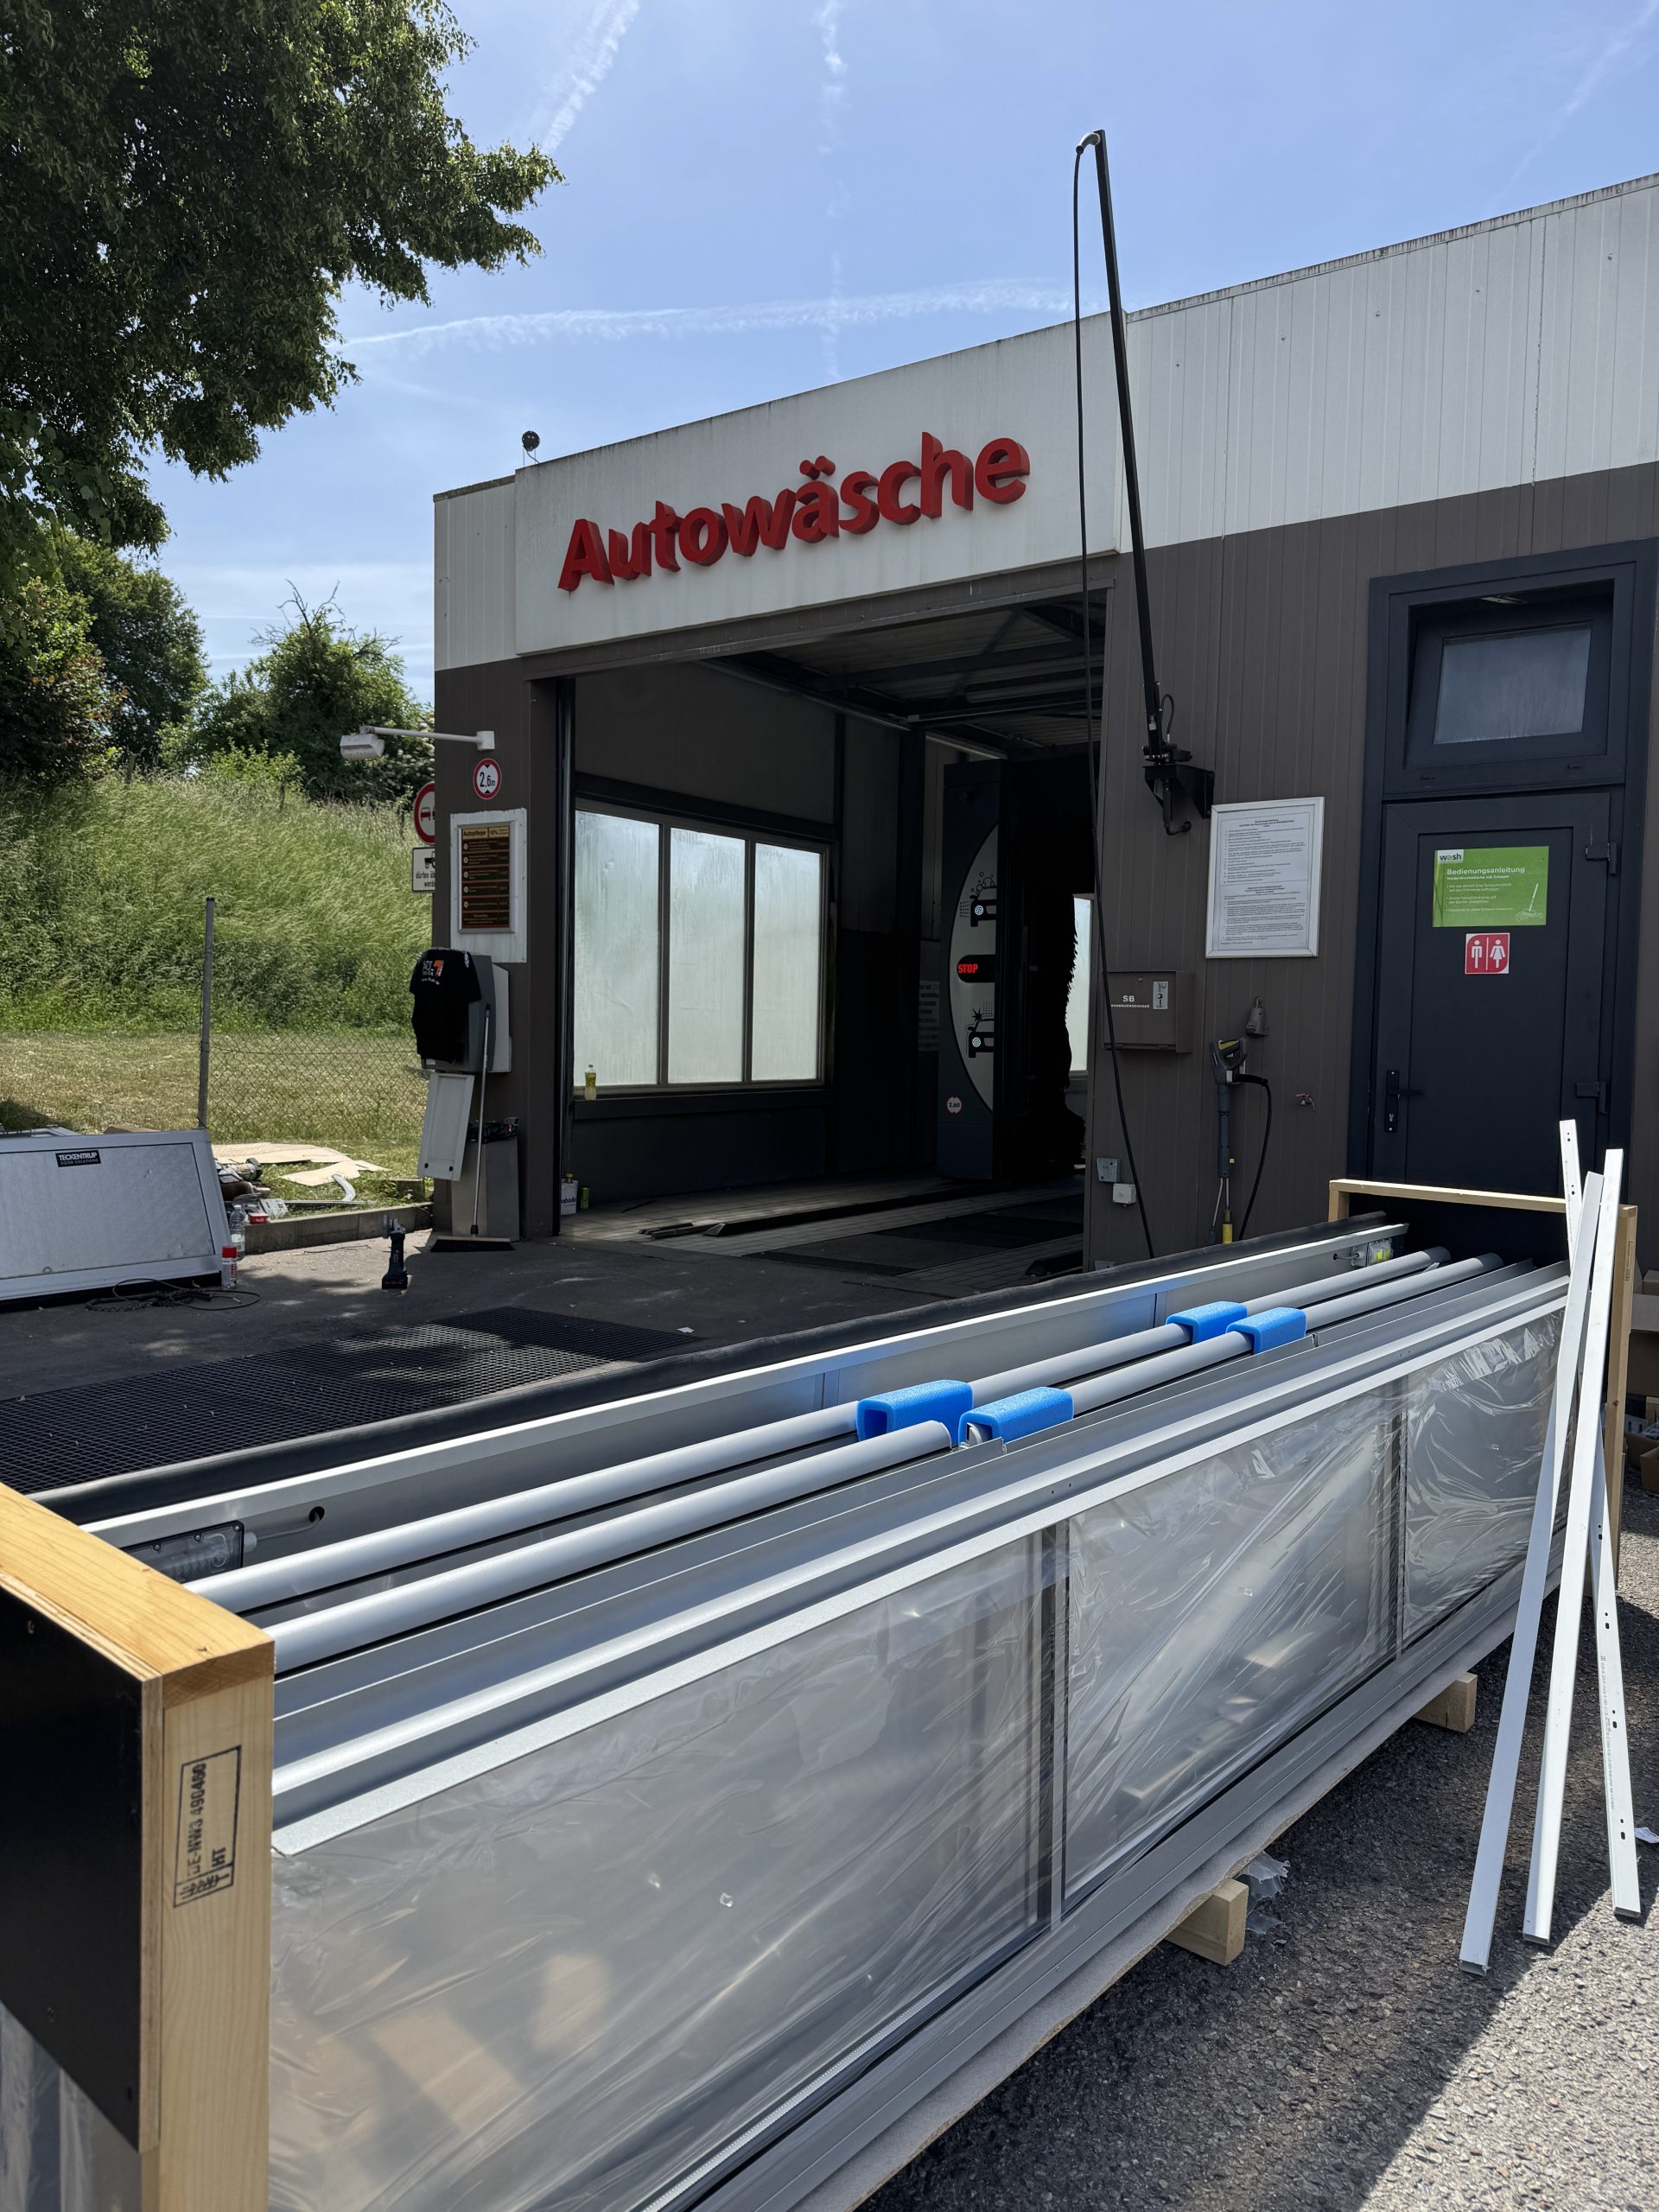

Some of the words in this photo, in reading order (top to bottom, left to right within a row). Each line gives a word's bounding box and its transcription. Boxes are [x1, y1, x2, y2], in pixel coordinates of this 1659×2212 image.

[558, 431, 1030, 591] Autowäsche
[1446, 867, 1525, 875] Bedienungsanleitung
[957, 963, 978, 973] STOP
[58, 1152, 98, 1160] TECKENTRUP
[212, 1847, 226, 1868] HT
